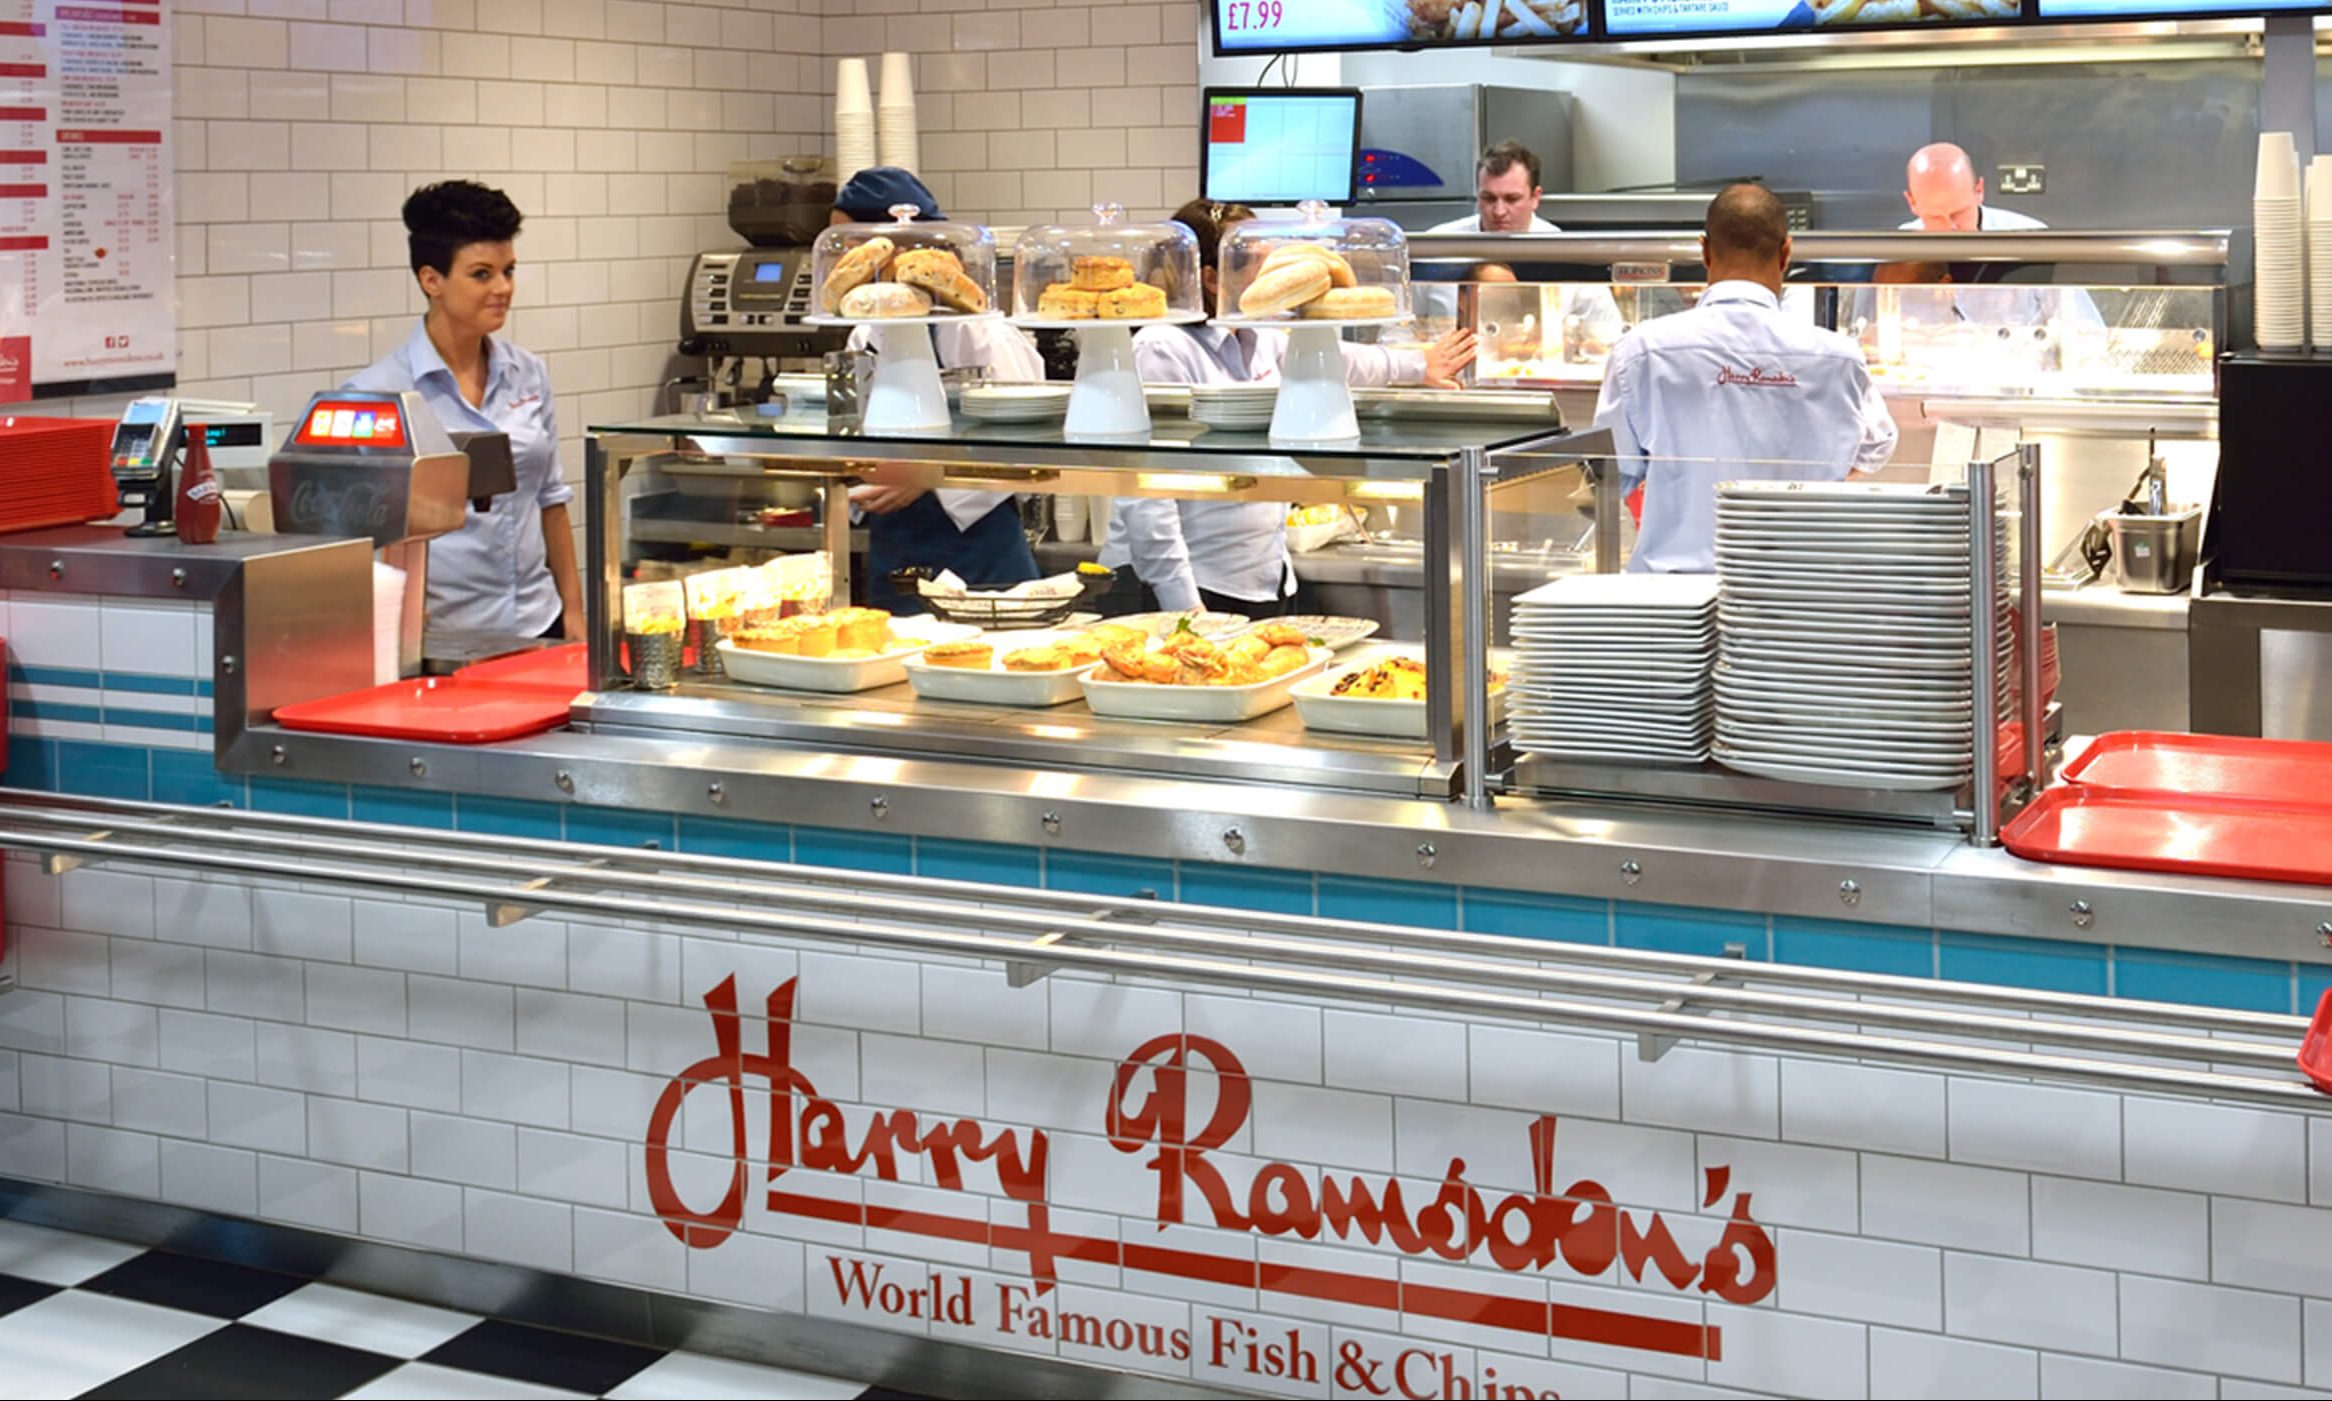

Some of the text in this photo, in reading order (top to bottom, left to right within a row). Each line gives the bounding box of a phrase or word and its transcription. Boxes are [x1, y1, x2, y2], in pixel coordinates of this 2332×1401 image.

[1228, 0, 1282, 30] £7.99
[645, 971, 1776, 1306] Harry Ramsden's
[826, 1256, 975, 1326] World
[995, 1283, 1192, 1361] Famous
[1207, 1316, 1319, 1385] Fish
[1335, 1340, 1391, 1396] &
